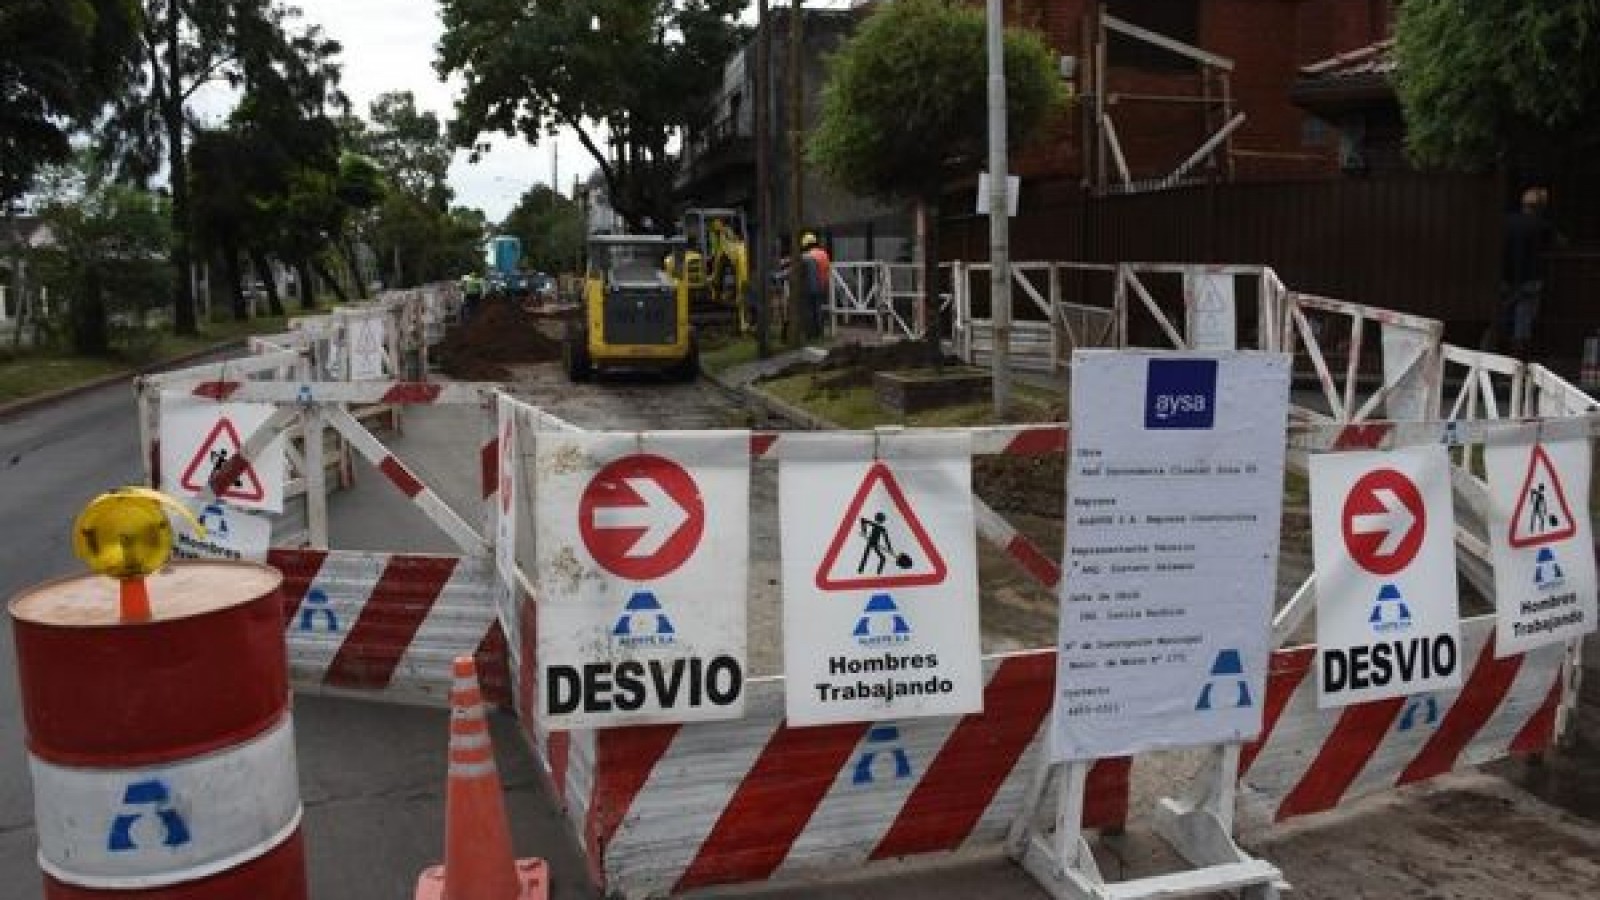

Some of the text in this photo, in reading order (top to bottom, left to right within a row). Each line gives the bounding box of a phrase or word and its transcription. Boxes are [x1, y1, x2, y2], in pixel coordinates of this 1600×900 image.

[1154, 393, 1206, 419] aysa
[1519, 592, 1578, 614] Hombres
[1513, 610, 1583, 638] Trabajando
[828, 651, 939, 677] Hombres
[1324, 633, 1456, 693] DESVIO
[546, 655, 744, 717] DESVIO
[814, 674, 954, 703] Trabajando
